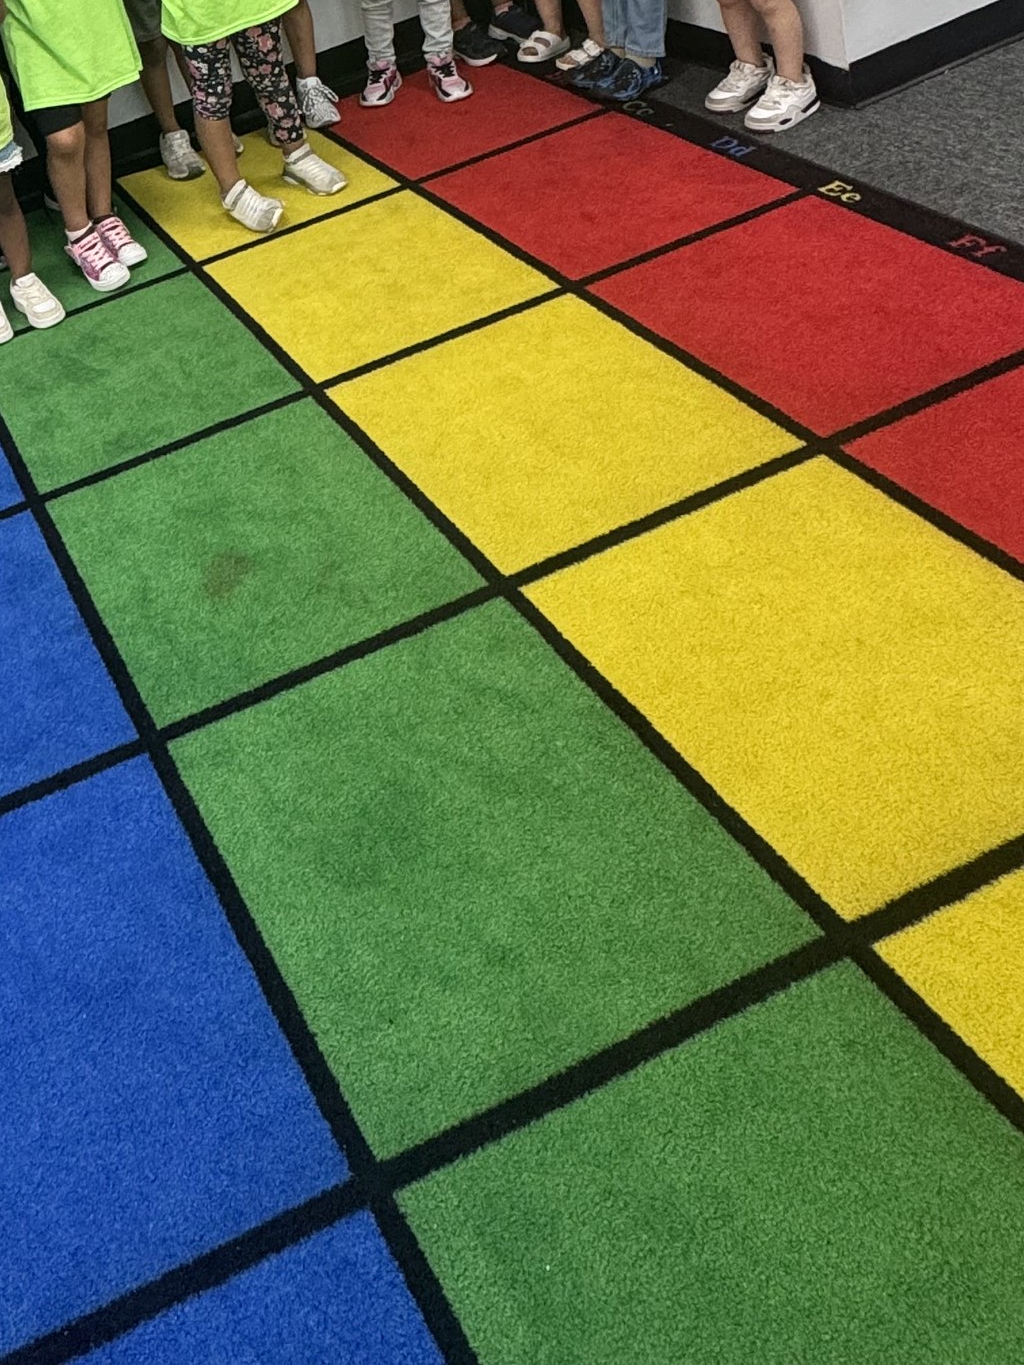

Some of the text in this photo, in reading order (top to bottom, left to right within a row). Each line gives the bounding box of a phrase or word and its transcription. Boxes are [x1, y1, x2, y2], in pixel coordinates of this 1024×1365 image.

[623, 100, 655, 115] Cc
[710, 135, 757, 157] Dd
[817, 180, 862, 204] Ee
[948, 234, 1006, 258] Ff
